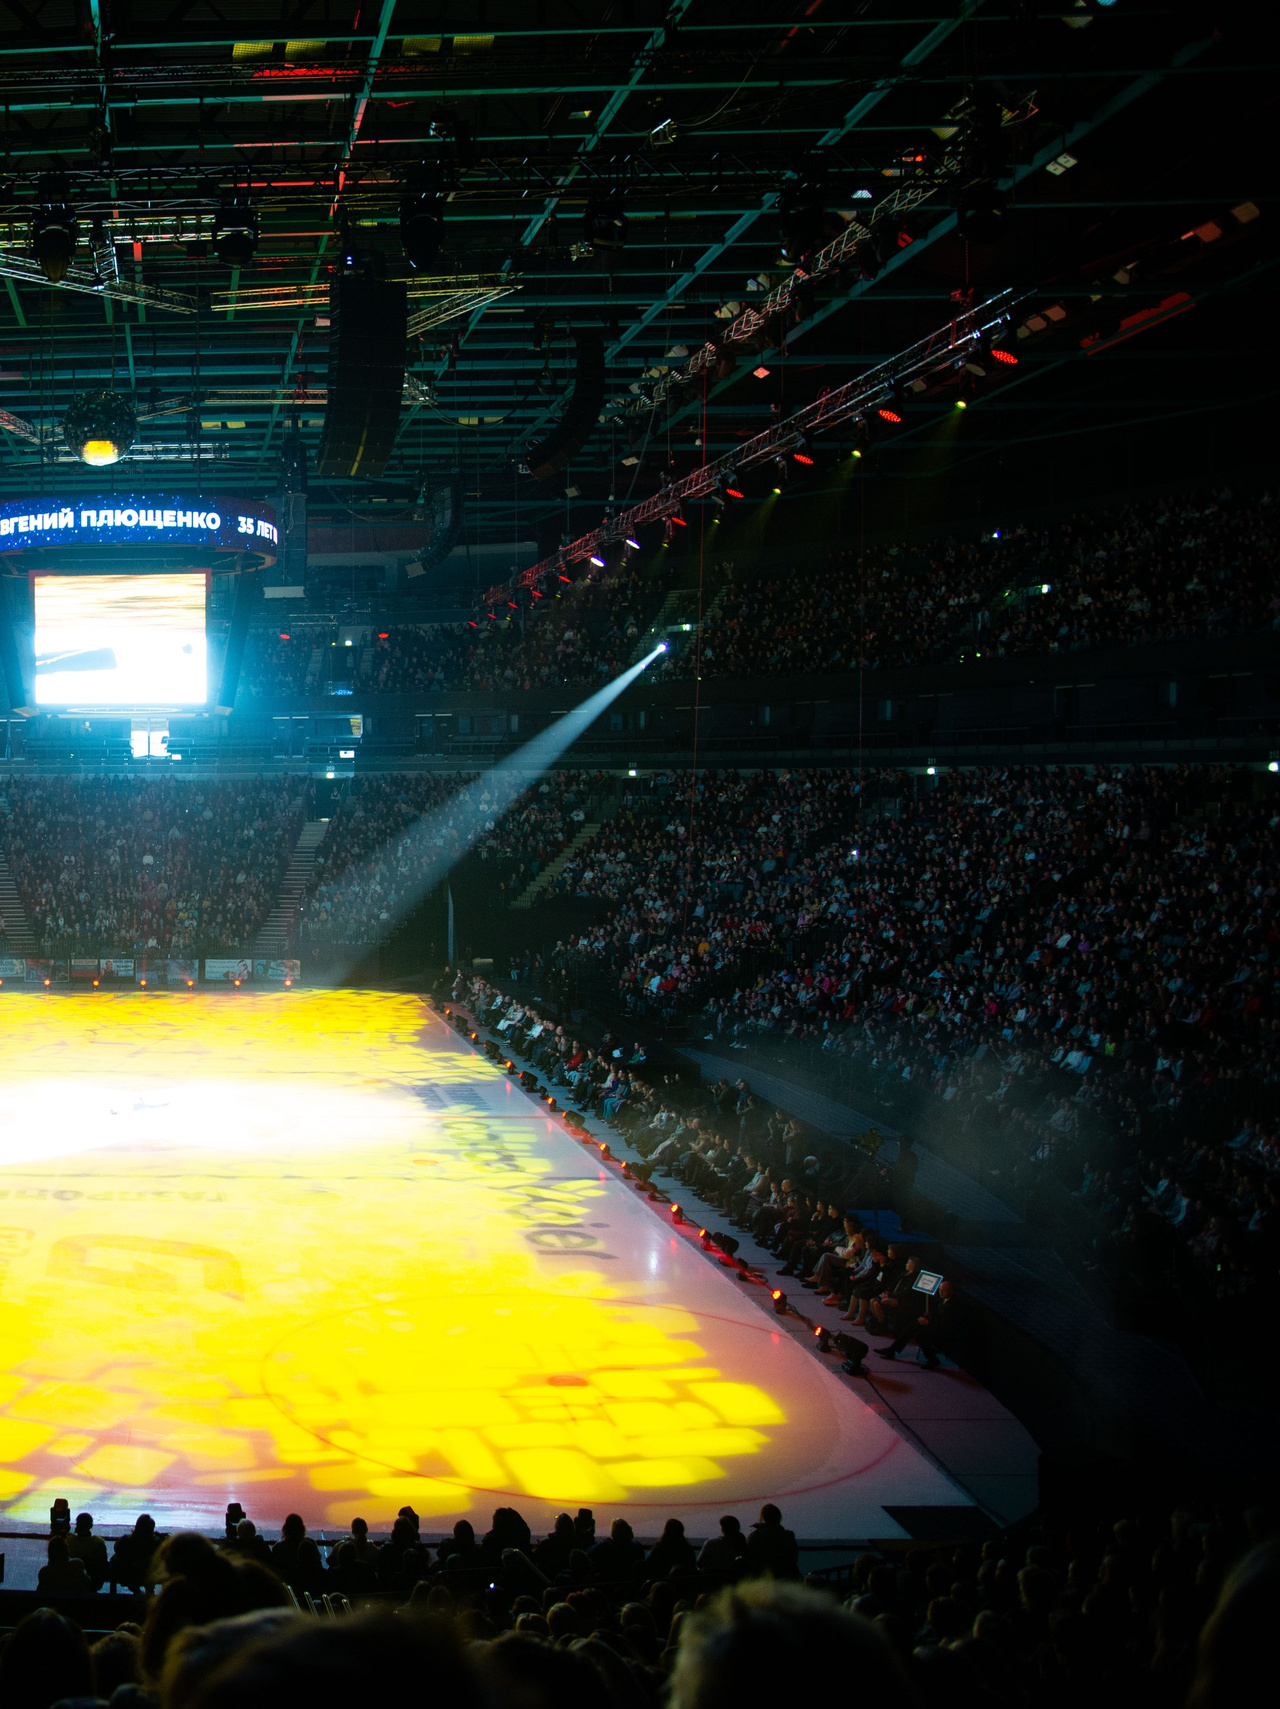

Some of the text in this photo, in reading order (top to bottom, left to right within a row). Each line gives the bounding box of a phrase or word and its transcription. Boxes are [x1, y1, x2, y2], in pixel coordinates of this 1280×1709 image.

[81, 509, 221, 530] ПЛЮЩЕНКО
[238, 516, 254, 534] 35
[256, 520, 273, 540] ЛЕТ
[488, 1184, 620, 1260] Haier
